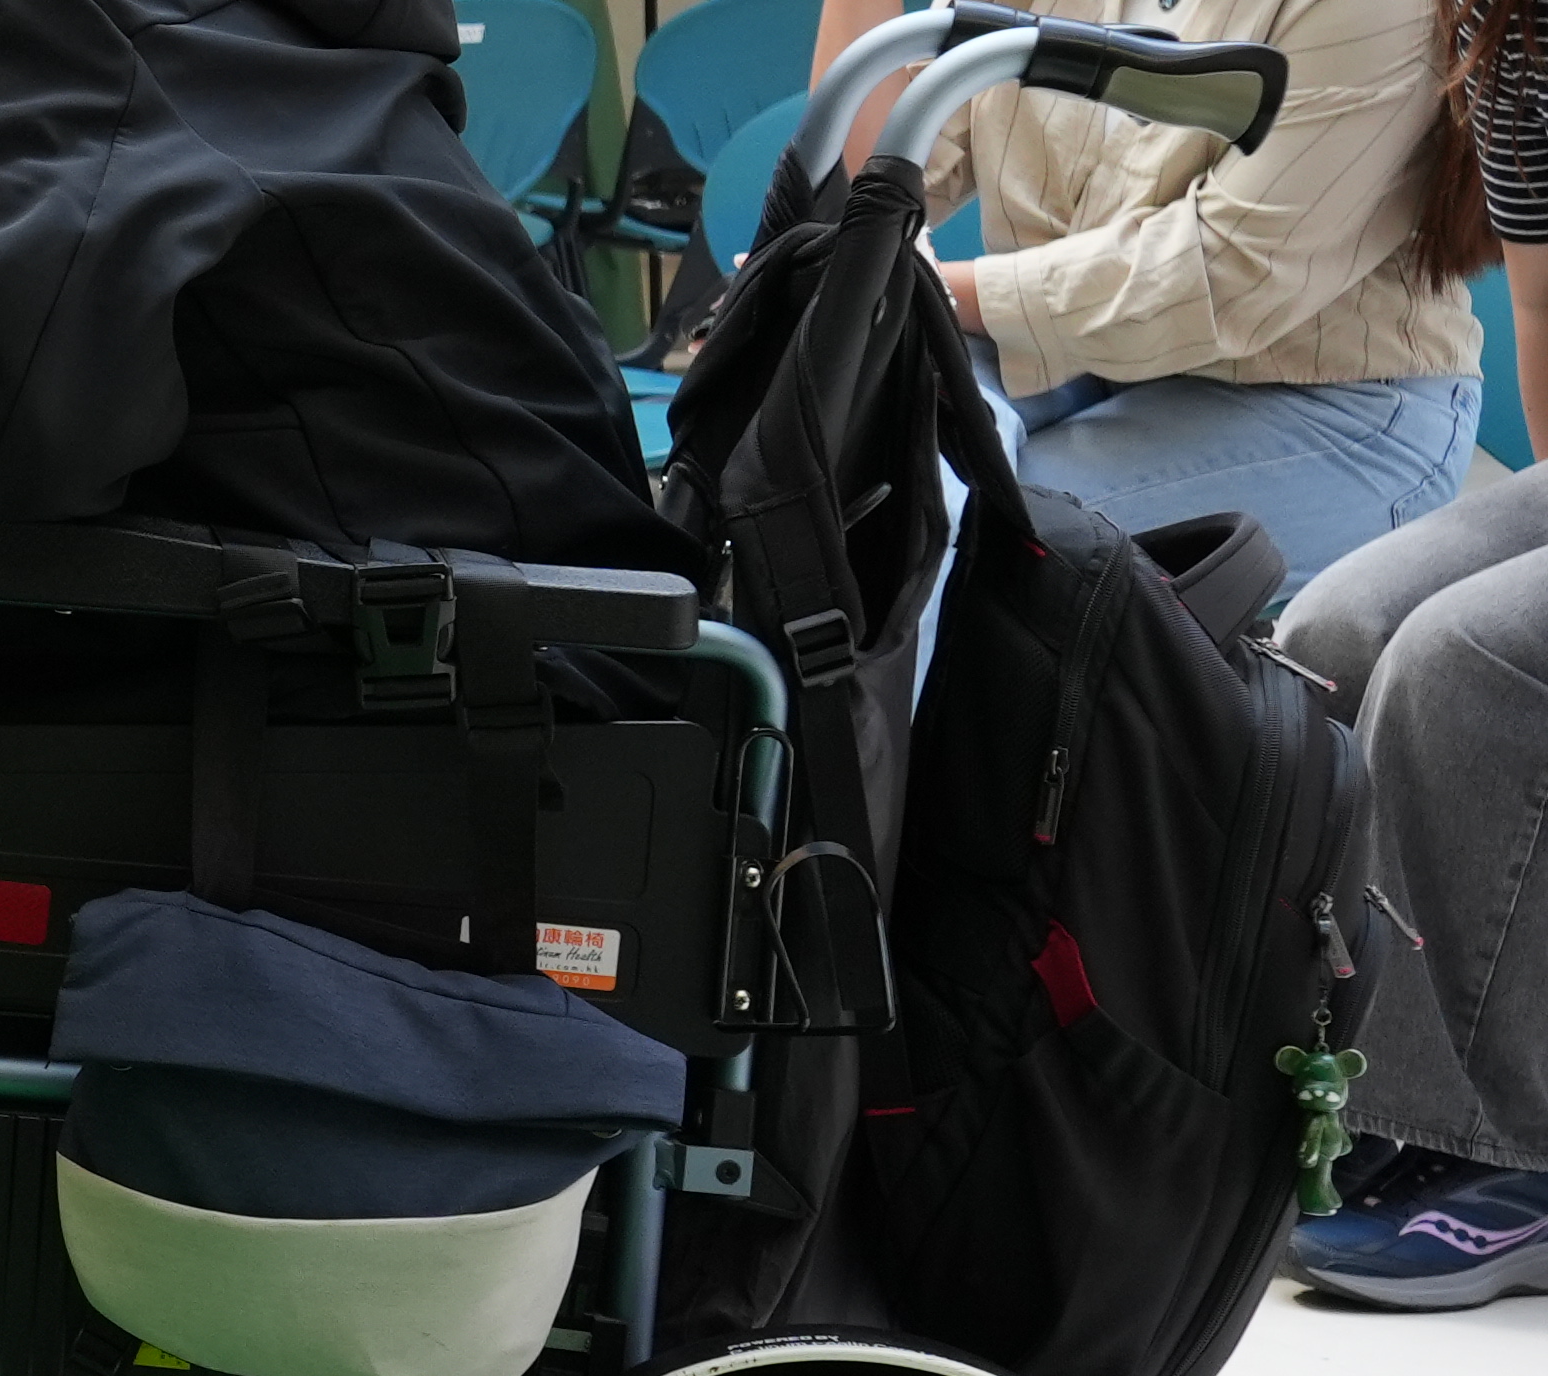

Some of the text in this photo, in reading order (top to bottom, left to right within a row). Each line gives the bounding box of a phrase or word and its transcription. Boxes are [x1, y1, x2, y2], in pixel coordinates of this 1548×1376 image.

[566, 946, 604, 962] Health
[727, 1334, 814, 1351] POWERED
[815, 1334, 841, 1343] BY
